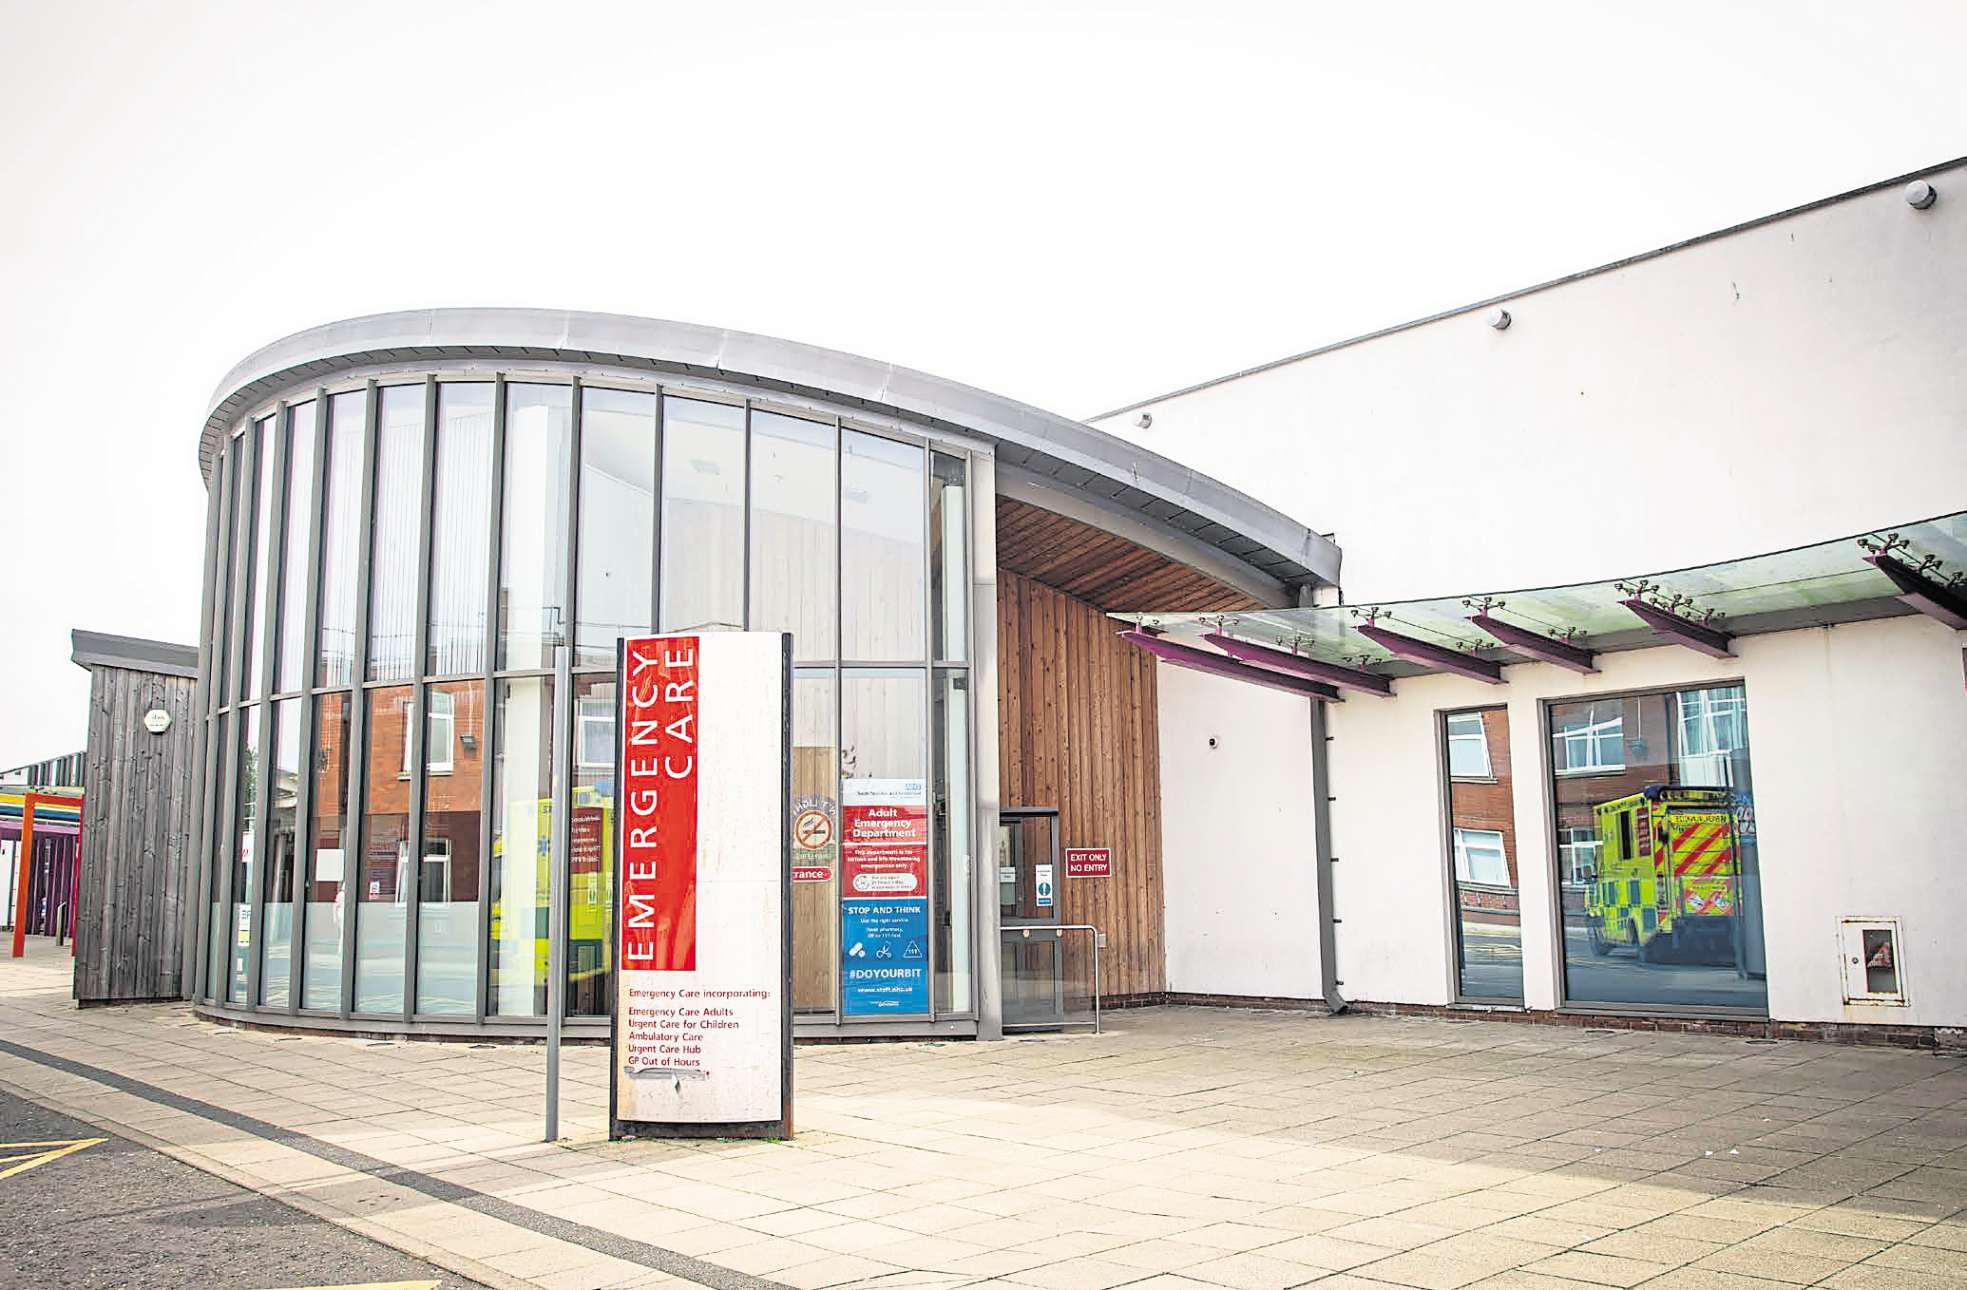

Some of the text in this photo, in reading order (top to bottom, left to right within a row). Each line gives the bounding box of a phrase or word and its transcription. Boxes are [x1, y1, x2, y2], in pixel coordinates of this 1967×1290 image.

[664, 648, 693, 779] CARE
[628, 650, 658, 961] EMERGENCY
[868, 808, 897, 817] Adult
[854, 819, 912, 829] Emergency
[853, 829, 916, 839] Department
[1070, 853, 1107, 861] EXIT ONLY
[1070, 864, 1107, 872] NO ENTRY
[848, 906, 921, 915] STOP AND THINK
[849, 968, 922, 980] #DOYOURBIT
[629, 988, 771, 999] Emergency Care incorporating:
[628, 1006, 734, 1018] Emergency Care Adults
[628, 1019, 740, 1029] Urgent Care for Children
[628, 1031, 704, 1042] Ambulatory Care
[628, 1044, 702, 1054] Urgent Care Hub
[628, 1056, 701, 1067] GP Out of Hours
